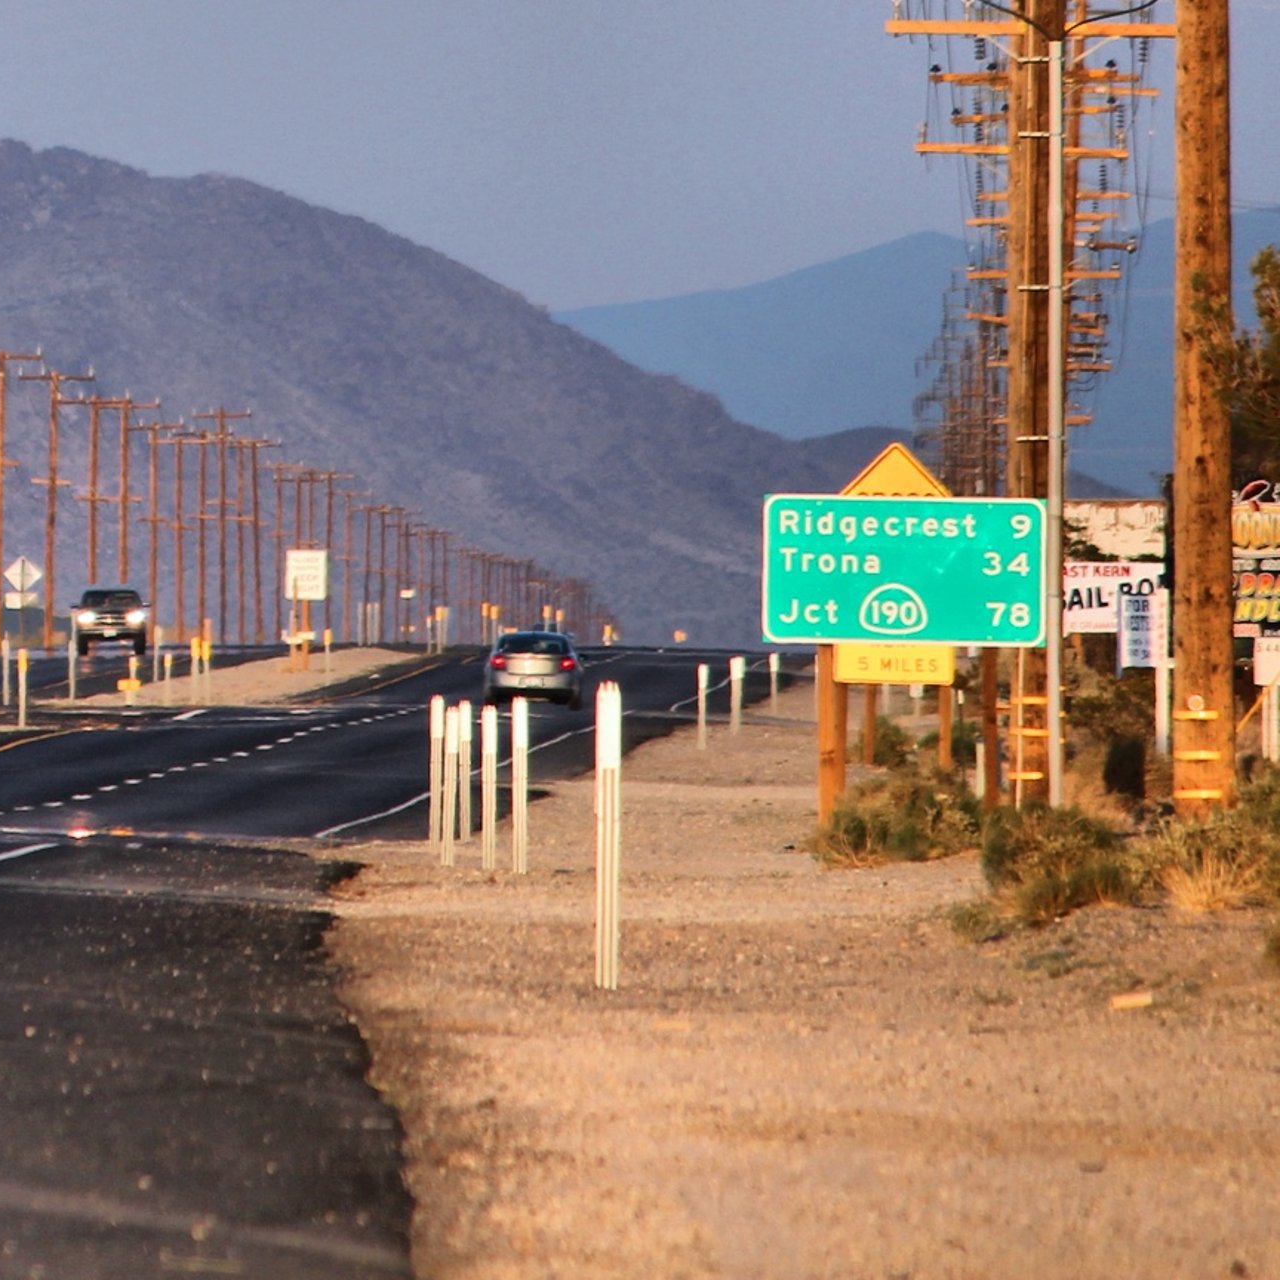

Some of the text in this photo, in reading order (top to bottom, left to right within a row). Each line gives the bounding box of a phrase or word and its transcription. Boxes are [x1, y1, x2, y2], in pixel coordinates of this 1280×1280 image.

[778, 509, 1032, 543] Ridgecrest 9
[779, 547, 1031, 577] Trona 34
[1061, 565, 1131, 577] AST KERN
[778, 599, 1032, 628] Jct 190 78
[857, 656, 938, 673] 5 MILES
